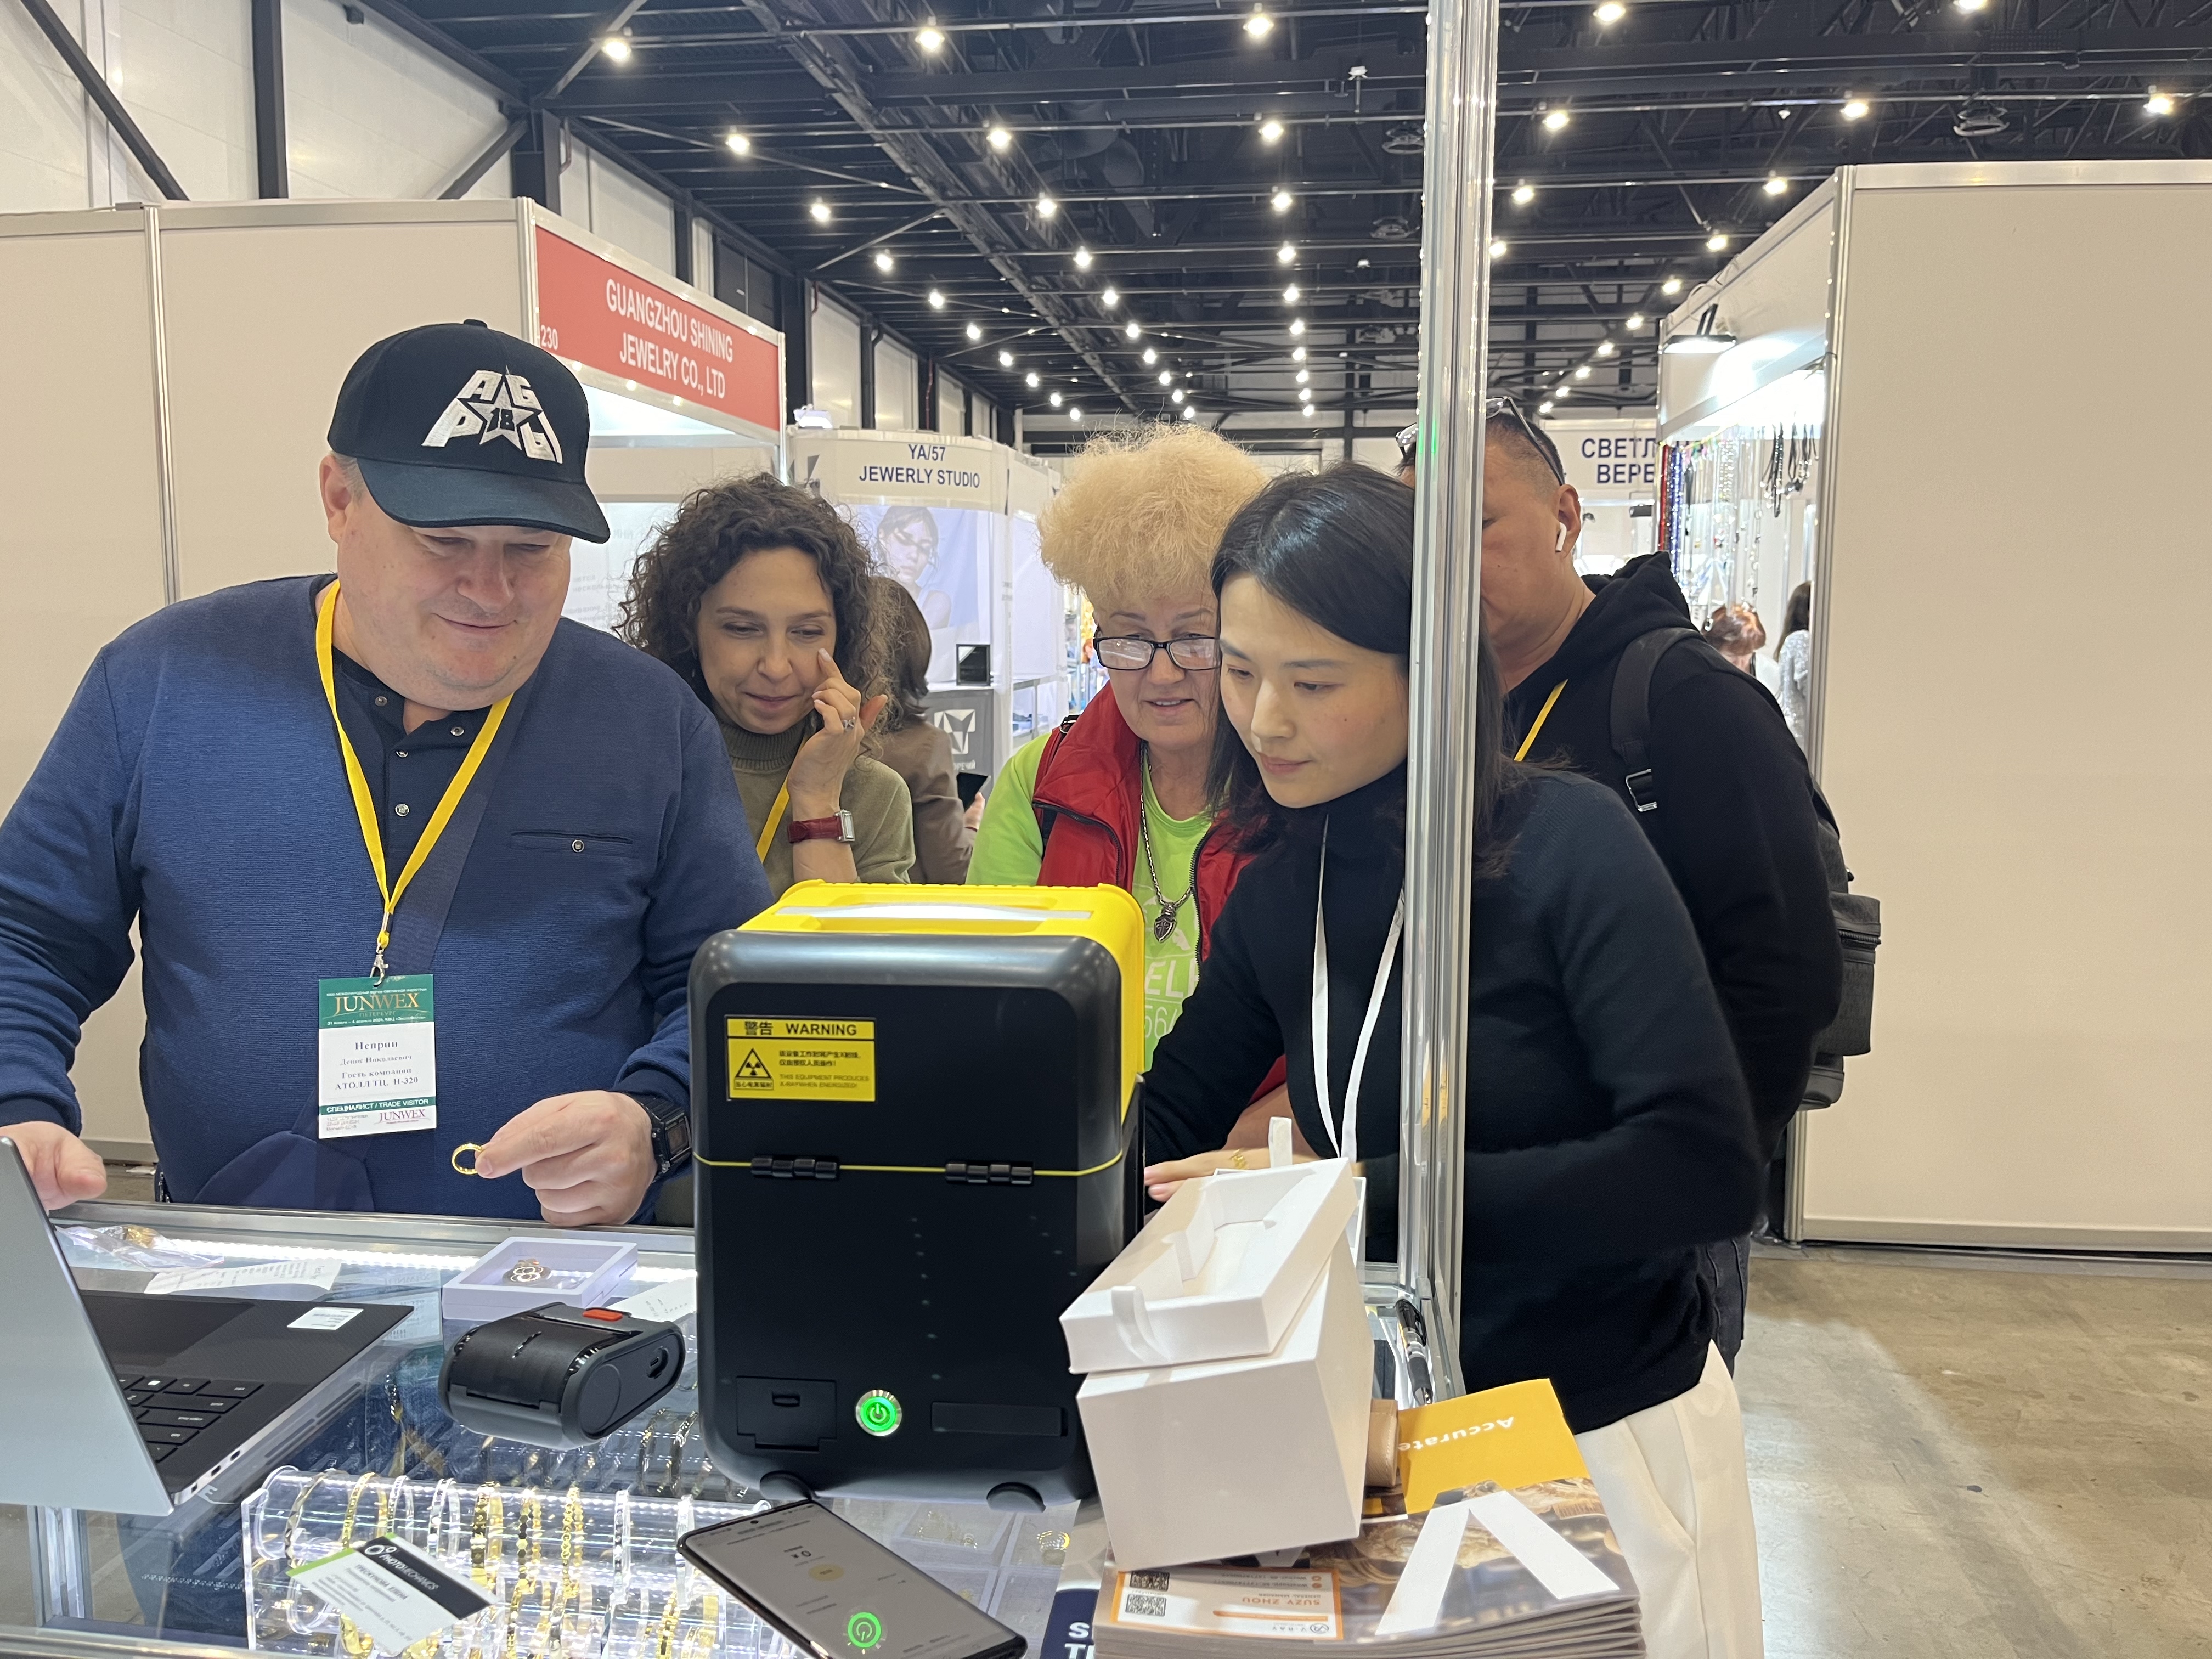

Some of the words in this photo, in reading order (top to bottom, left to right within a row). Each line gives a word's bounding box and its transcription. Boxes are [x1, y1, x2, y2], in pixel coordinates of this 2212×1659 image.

[606, 278, 688, 343] GUANGZHOU
[690, 318, 733, 363] SHINING
[540, 324, 558, 351] 230
[619, 332, 679, 381] JEWELRY
[681, 356, 704, 396] CO.,
[706, 366, 725, 399] LTD
[908, 444, 946, 462] YA/57
[859, 465, 933, 484] JEWERLY
[936, 469, 980, 488] STUDIO
[334, 992, 420, 1017] JUNWEX
[744, 1020, 774, 1036] 警告
[785, 1023, 857, 1036] WARNING
[326, 1103, 374, 1113] СПЕЦИАЛИСТ
[402, 1098, 429, 1106] VISITOR
[379, 1108, 426, 1124] JUNWEX
[1397, 1415, 1515, 1452] Accurate
[1242, 1597, 1280, 1605] ZHOU
